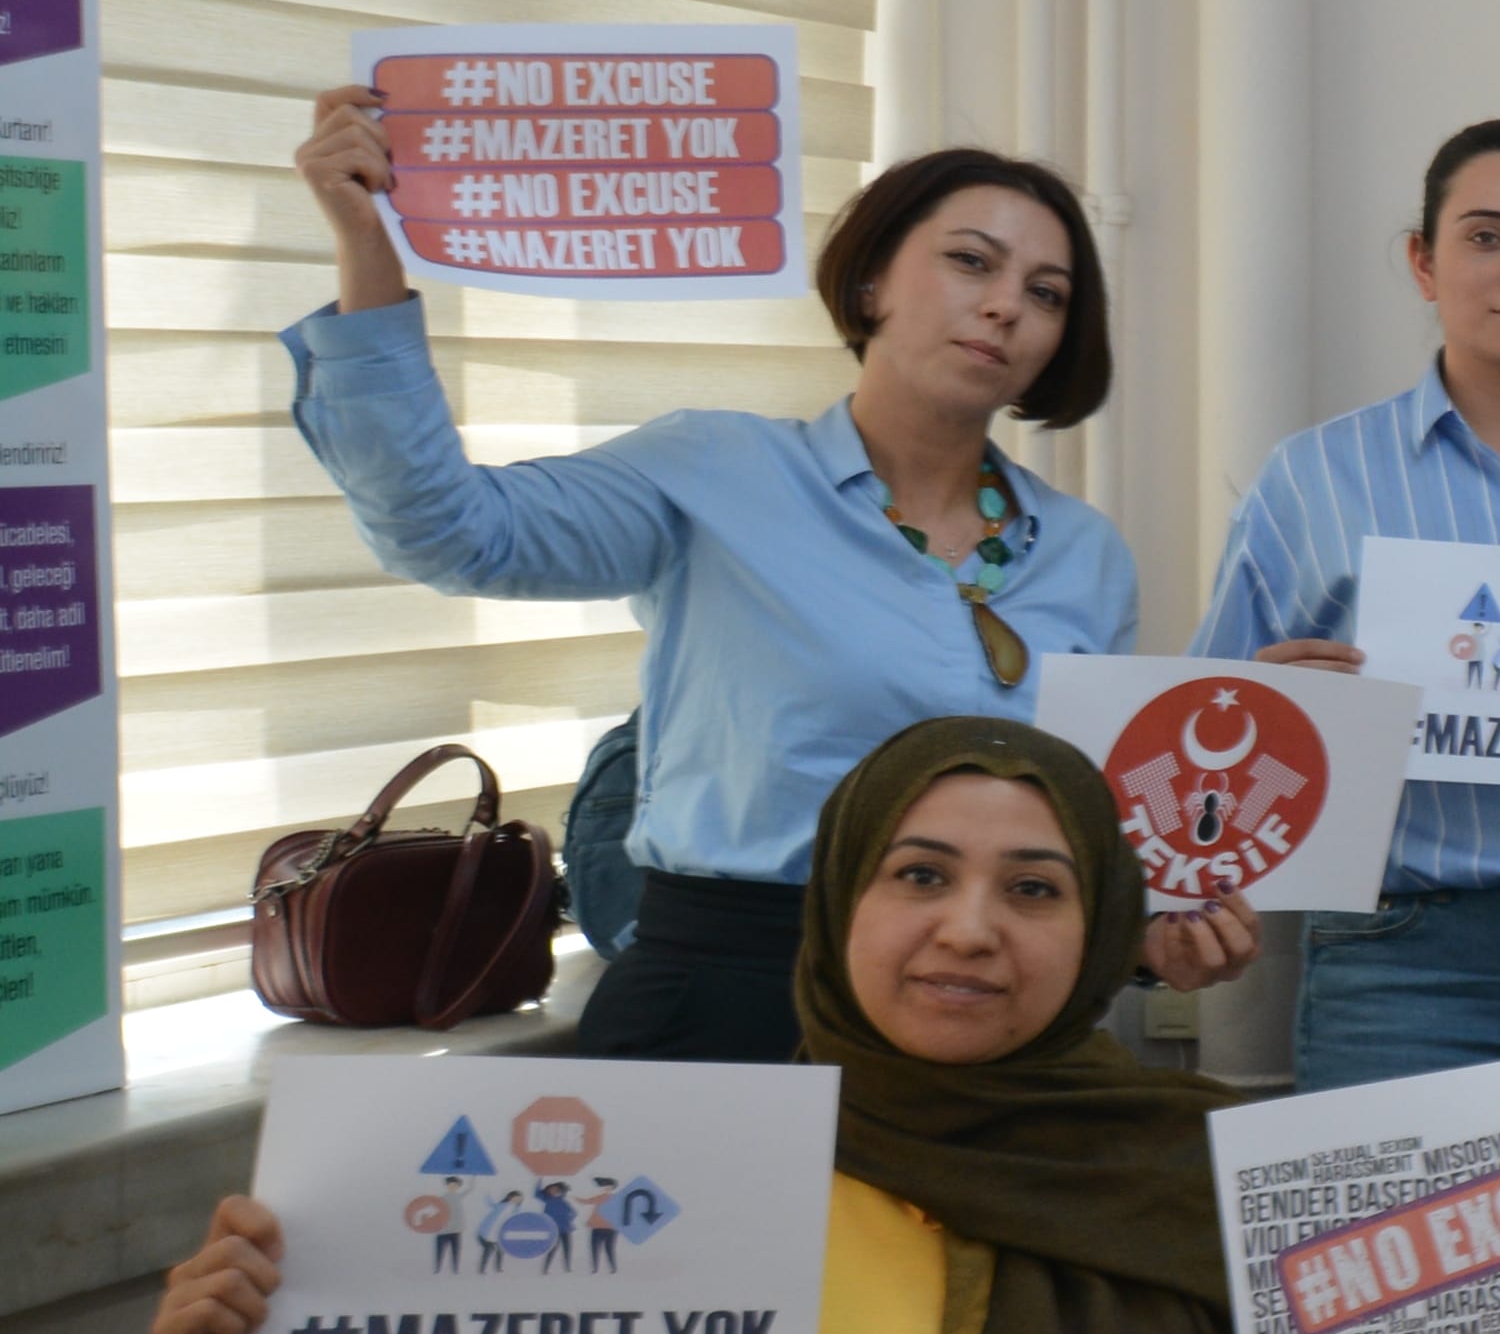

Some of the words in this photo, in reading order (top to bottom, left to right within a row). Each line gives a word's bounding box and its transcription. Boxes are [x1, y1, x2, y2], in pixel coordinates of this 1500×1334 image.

[443, 61, 553, 107] #NO
[562, 60, 717, 107] EXCUSE
[421, 118, 652, 162] #MAZERET
[661, 117, 740, 160] YOK
[452, 173, 560, 218] #NO
[569, 170, 720, 217] EXCUSE
[442, 227, 658, 271] #MAZERET
[666, 225, 747, 269] YOK
[526, 1120, 584, 1154] DUR
[1237, 1157, 1310, 1193] SEXISM
[1311, 1154, 1413, 1185] HARASSMENT
[1239, 1186, 1340, 1225] GENDER
[1294, 1224, 1422, 1325] #NO
